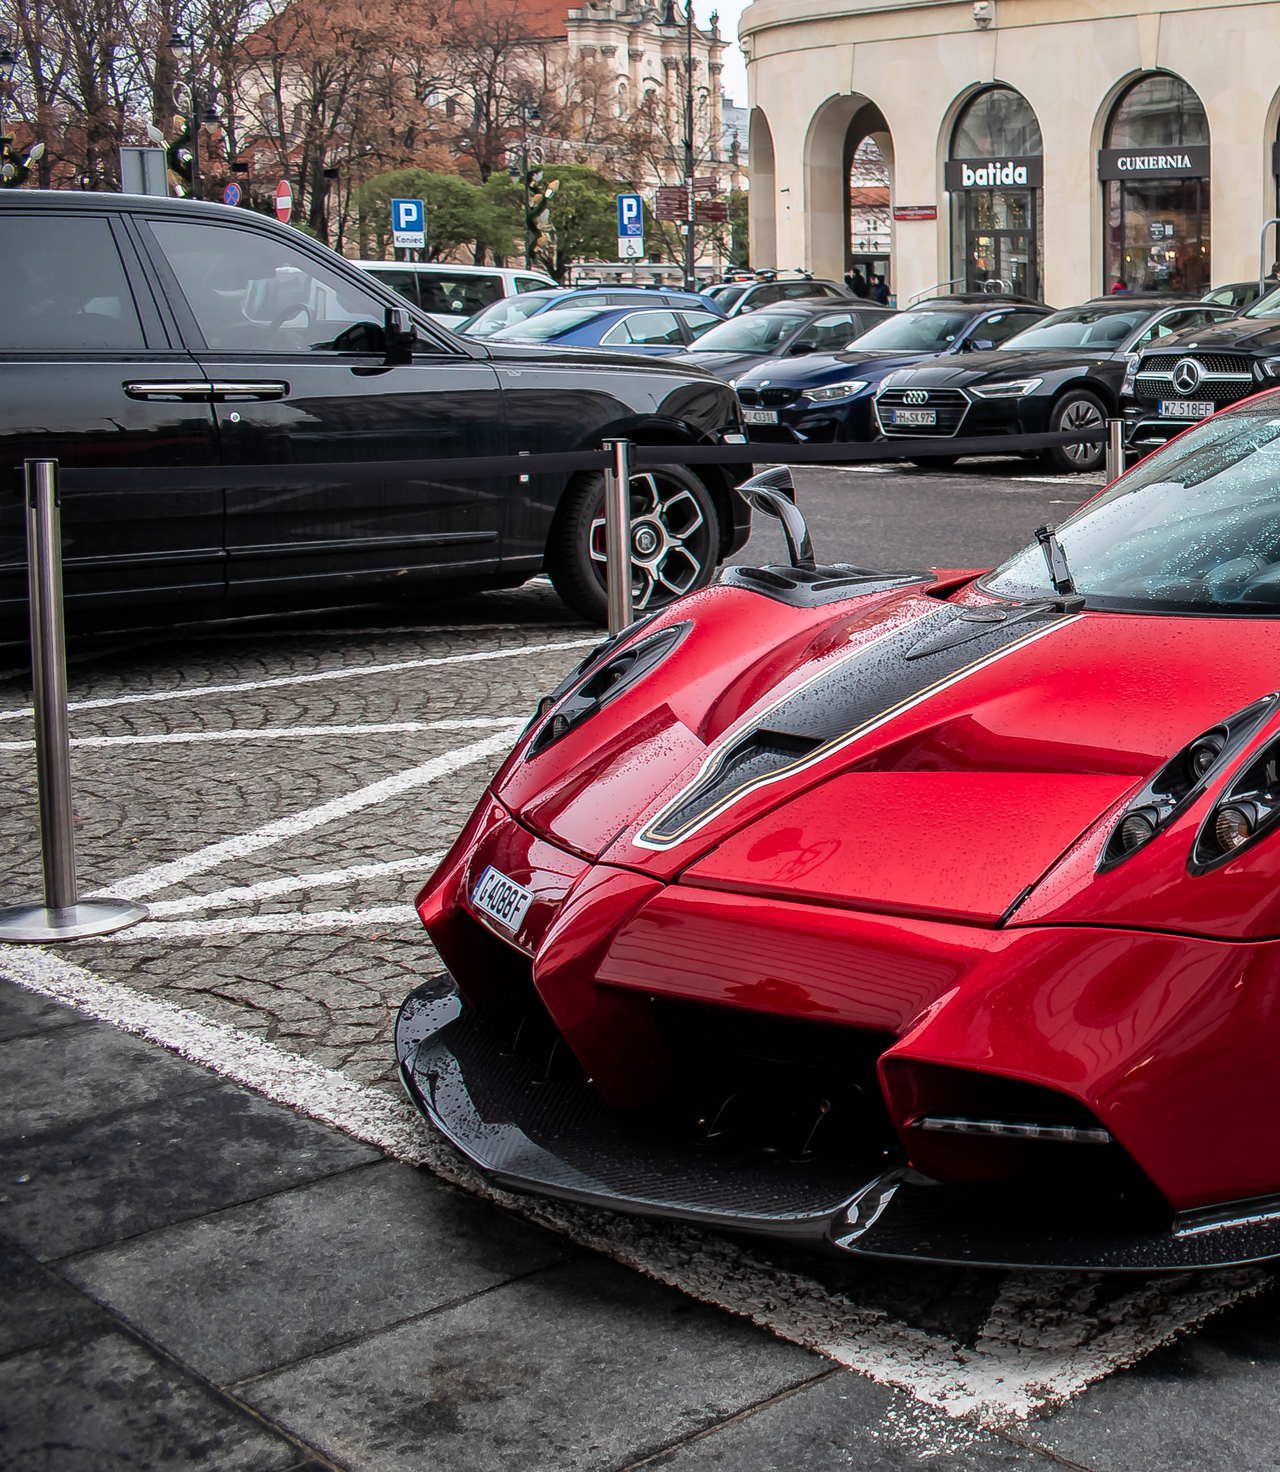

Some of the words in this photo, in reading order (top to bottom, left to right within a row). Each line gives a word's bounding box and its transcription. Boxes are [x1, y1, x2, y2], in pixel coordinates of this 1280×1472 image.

[962, 161, 1028, 187] batida
[1117, 154, 1192, 171] CUKIERNIA
[399, 203, 418, 229] P
[622, 198, 638, 225] P
[1180, 402, 1212, 416] 518EF
